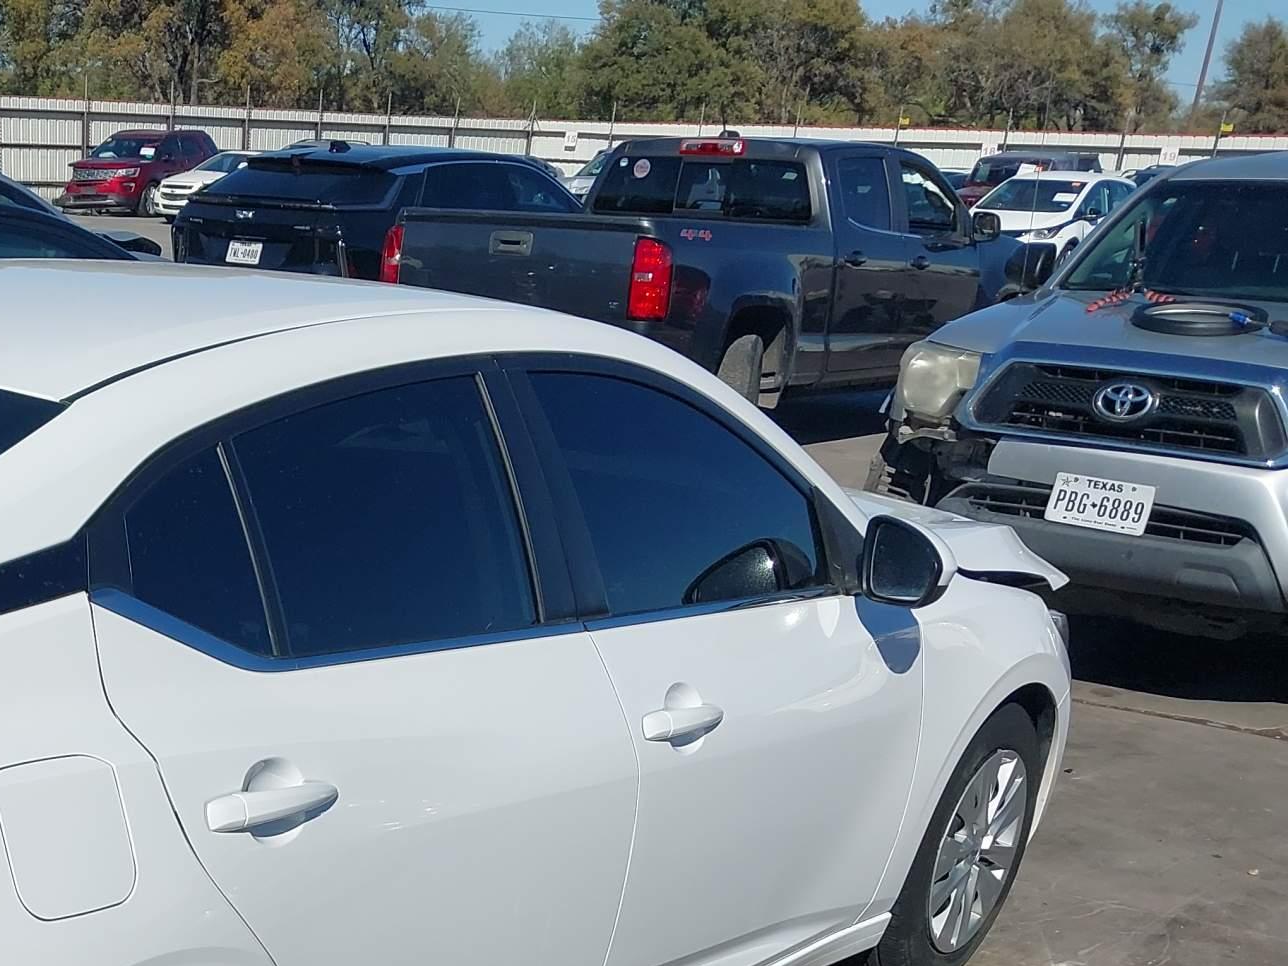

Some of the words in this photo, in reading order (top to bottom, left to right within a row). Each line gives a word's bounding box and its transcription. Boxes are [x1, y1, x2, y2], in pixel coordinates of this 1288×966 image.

[1162, 151, 1177, 161] 19
[1087, 479, 1124, 493] TEXAS
[1053, 489, 1090, 514] PBG
[1096, 496, 1145, 524] 6889
